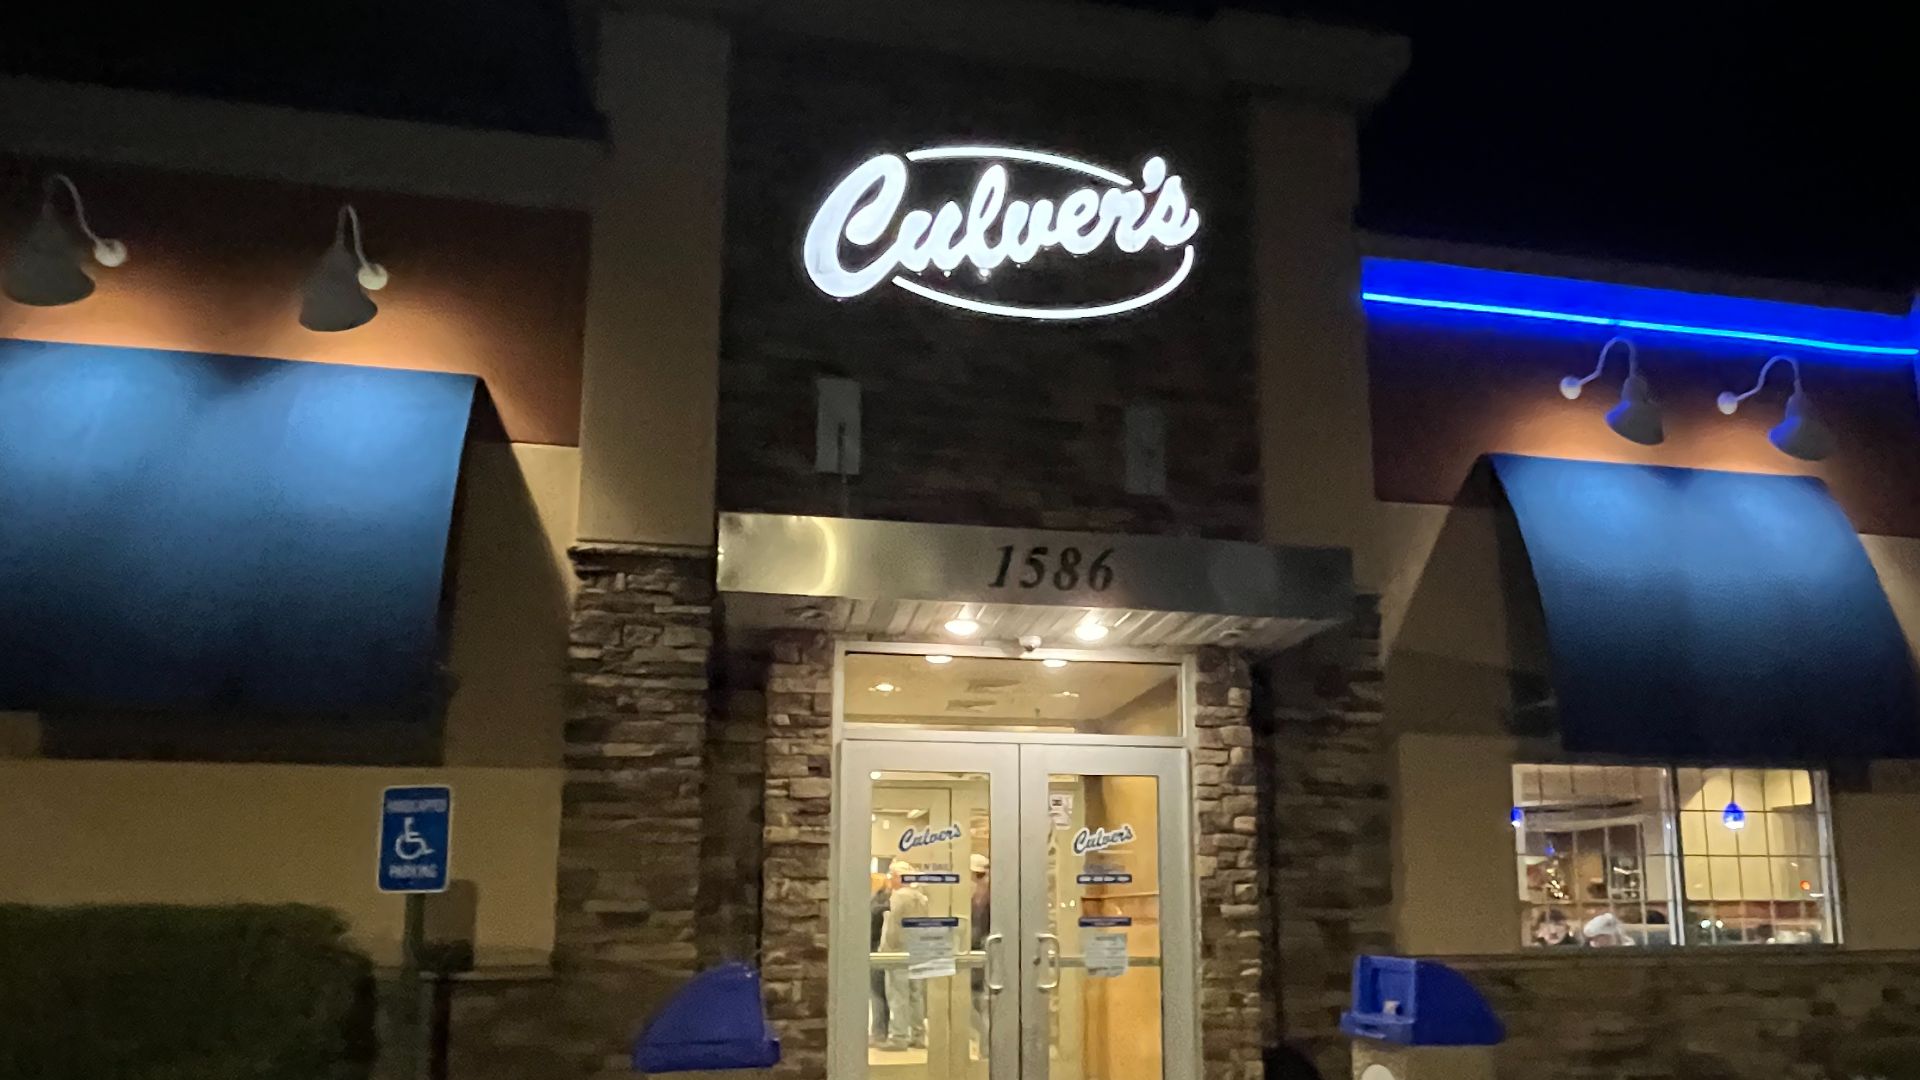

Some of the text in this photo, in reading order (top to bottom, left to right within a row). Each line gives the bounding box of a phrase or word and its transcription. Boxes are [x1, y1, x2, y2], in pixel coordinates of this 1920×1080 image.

[803, 153, 1200, 298] Culver's
[988, 545, 1115, 592] 1586
[899, 823, 962, 852] Culver's
[1074, 825, 1134, 854] Culver's
